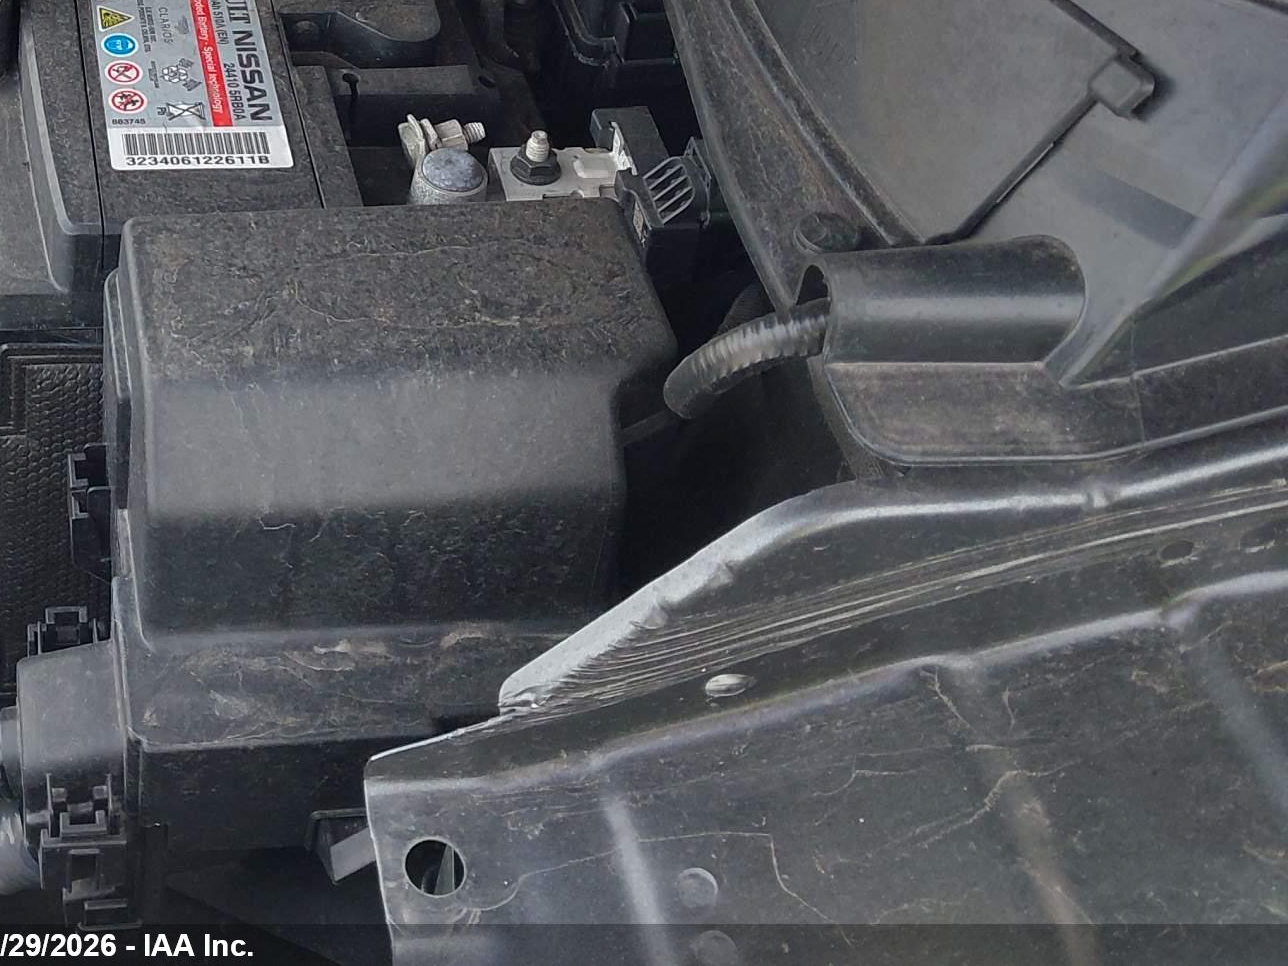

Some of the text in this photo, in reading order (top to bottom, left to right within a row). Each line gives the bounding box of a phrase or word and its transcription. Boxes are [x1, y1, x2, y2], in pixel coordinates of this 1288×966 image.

[198, 16, 210, 42] Battery
[202, 46, 217, 73] Special
[213, 11, 226, 29] 510A
[223, 62, 240, 88] 24410
[232, 30, 273, 121] NISSAN
[208, 73, 223, 114] technology
[126, 154, 270, 166] 323406122611B
